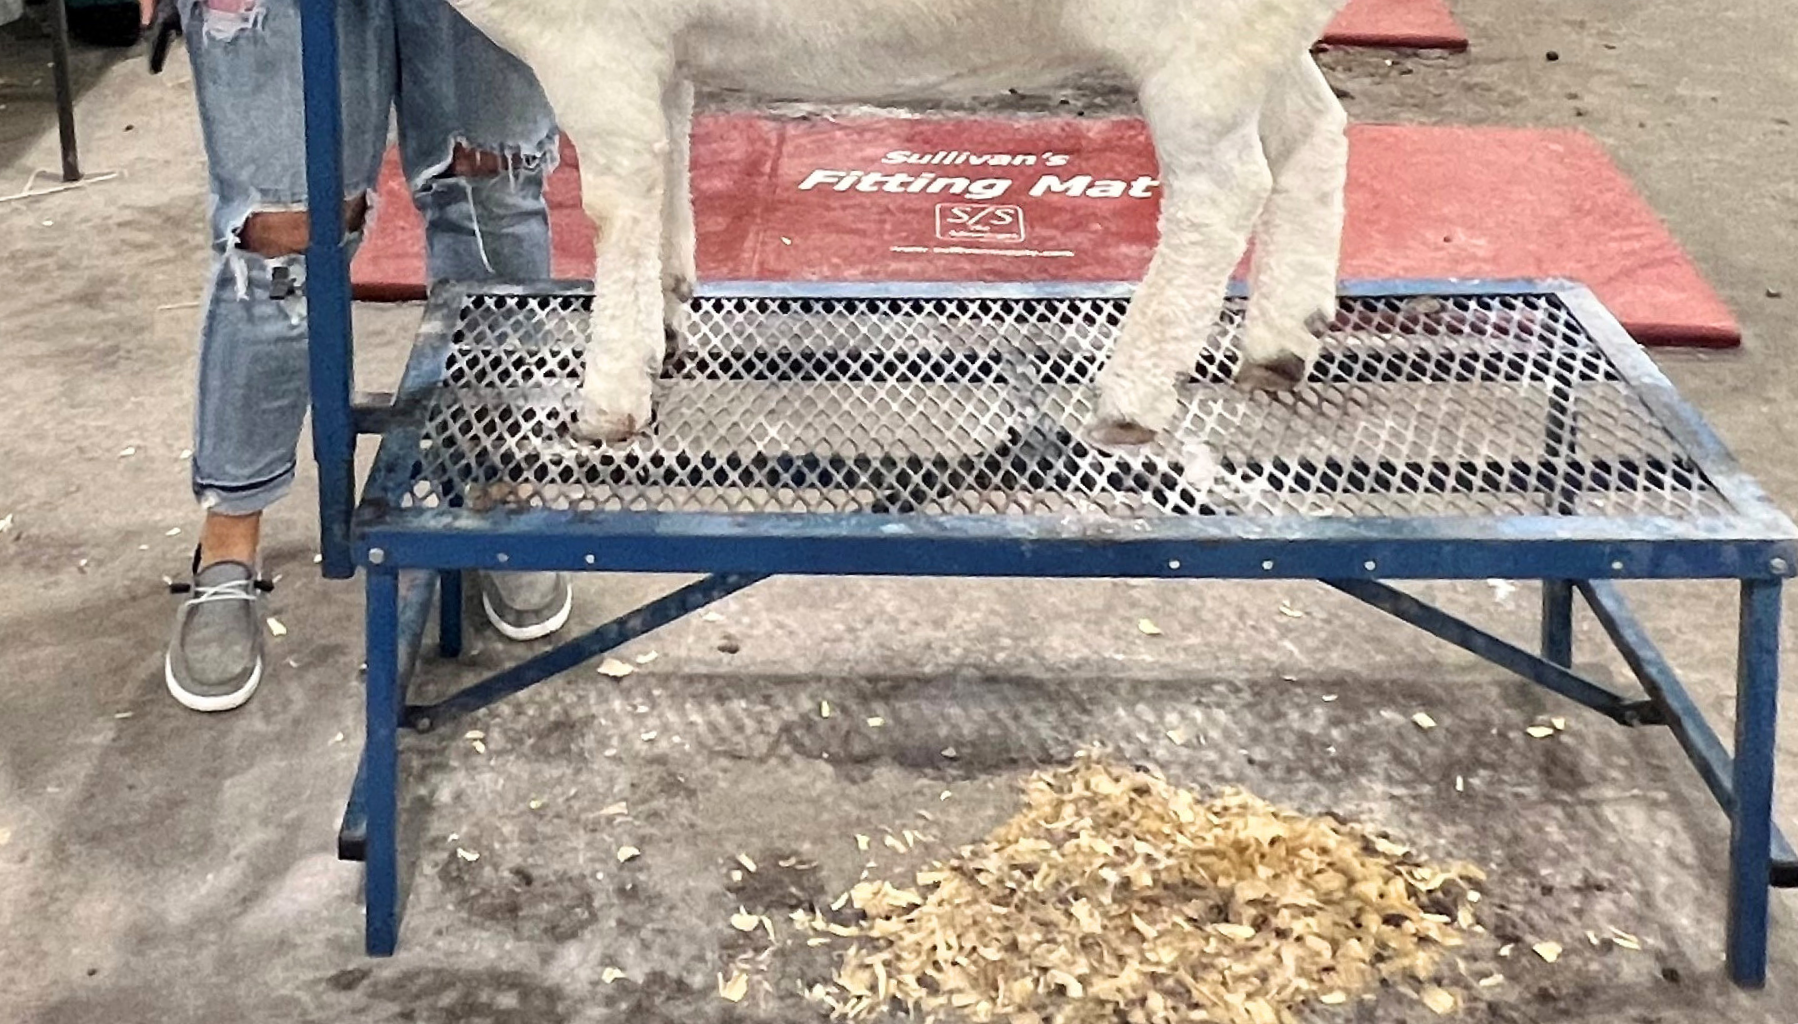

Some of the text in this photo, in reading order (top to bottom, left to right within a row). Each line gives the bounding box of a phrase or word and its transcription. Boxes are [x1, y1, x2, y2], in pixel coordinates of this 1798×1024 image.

[881, 149, 1071, 167] Sullivan's
[797, 168, 1161, 201] Fitting Mat
